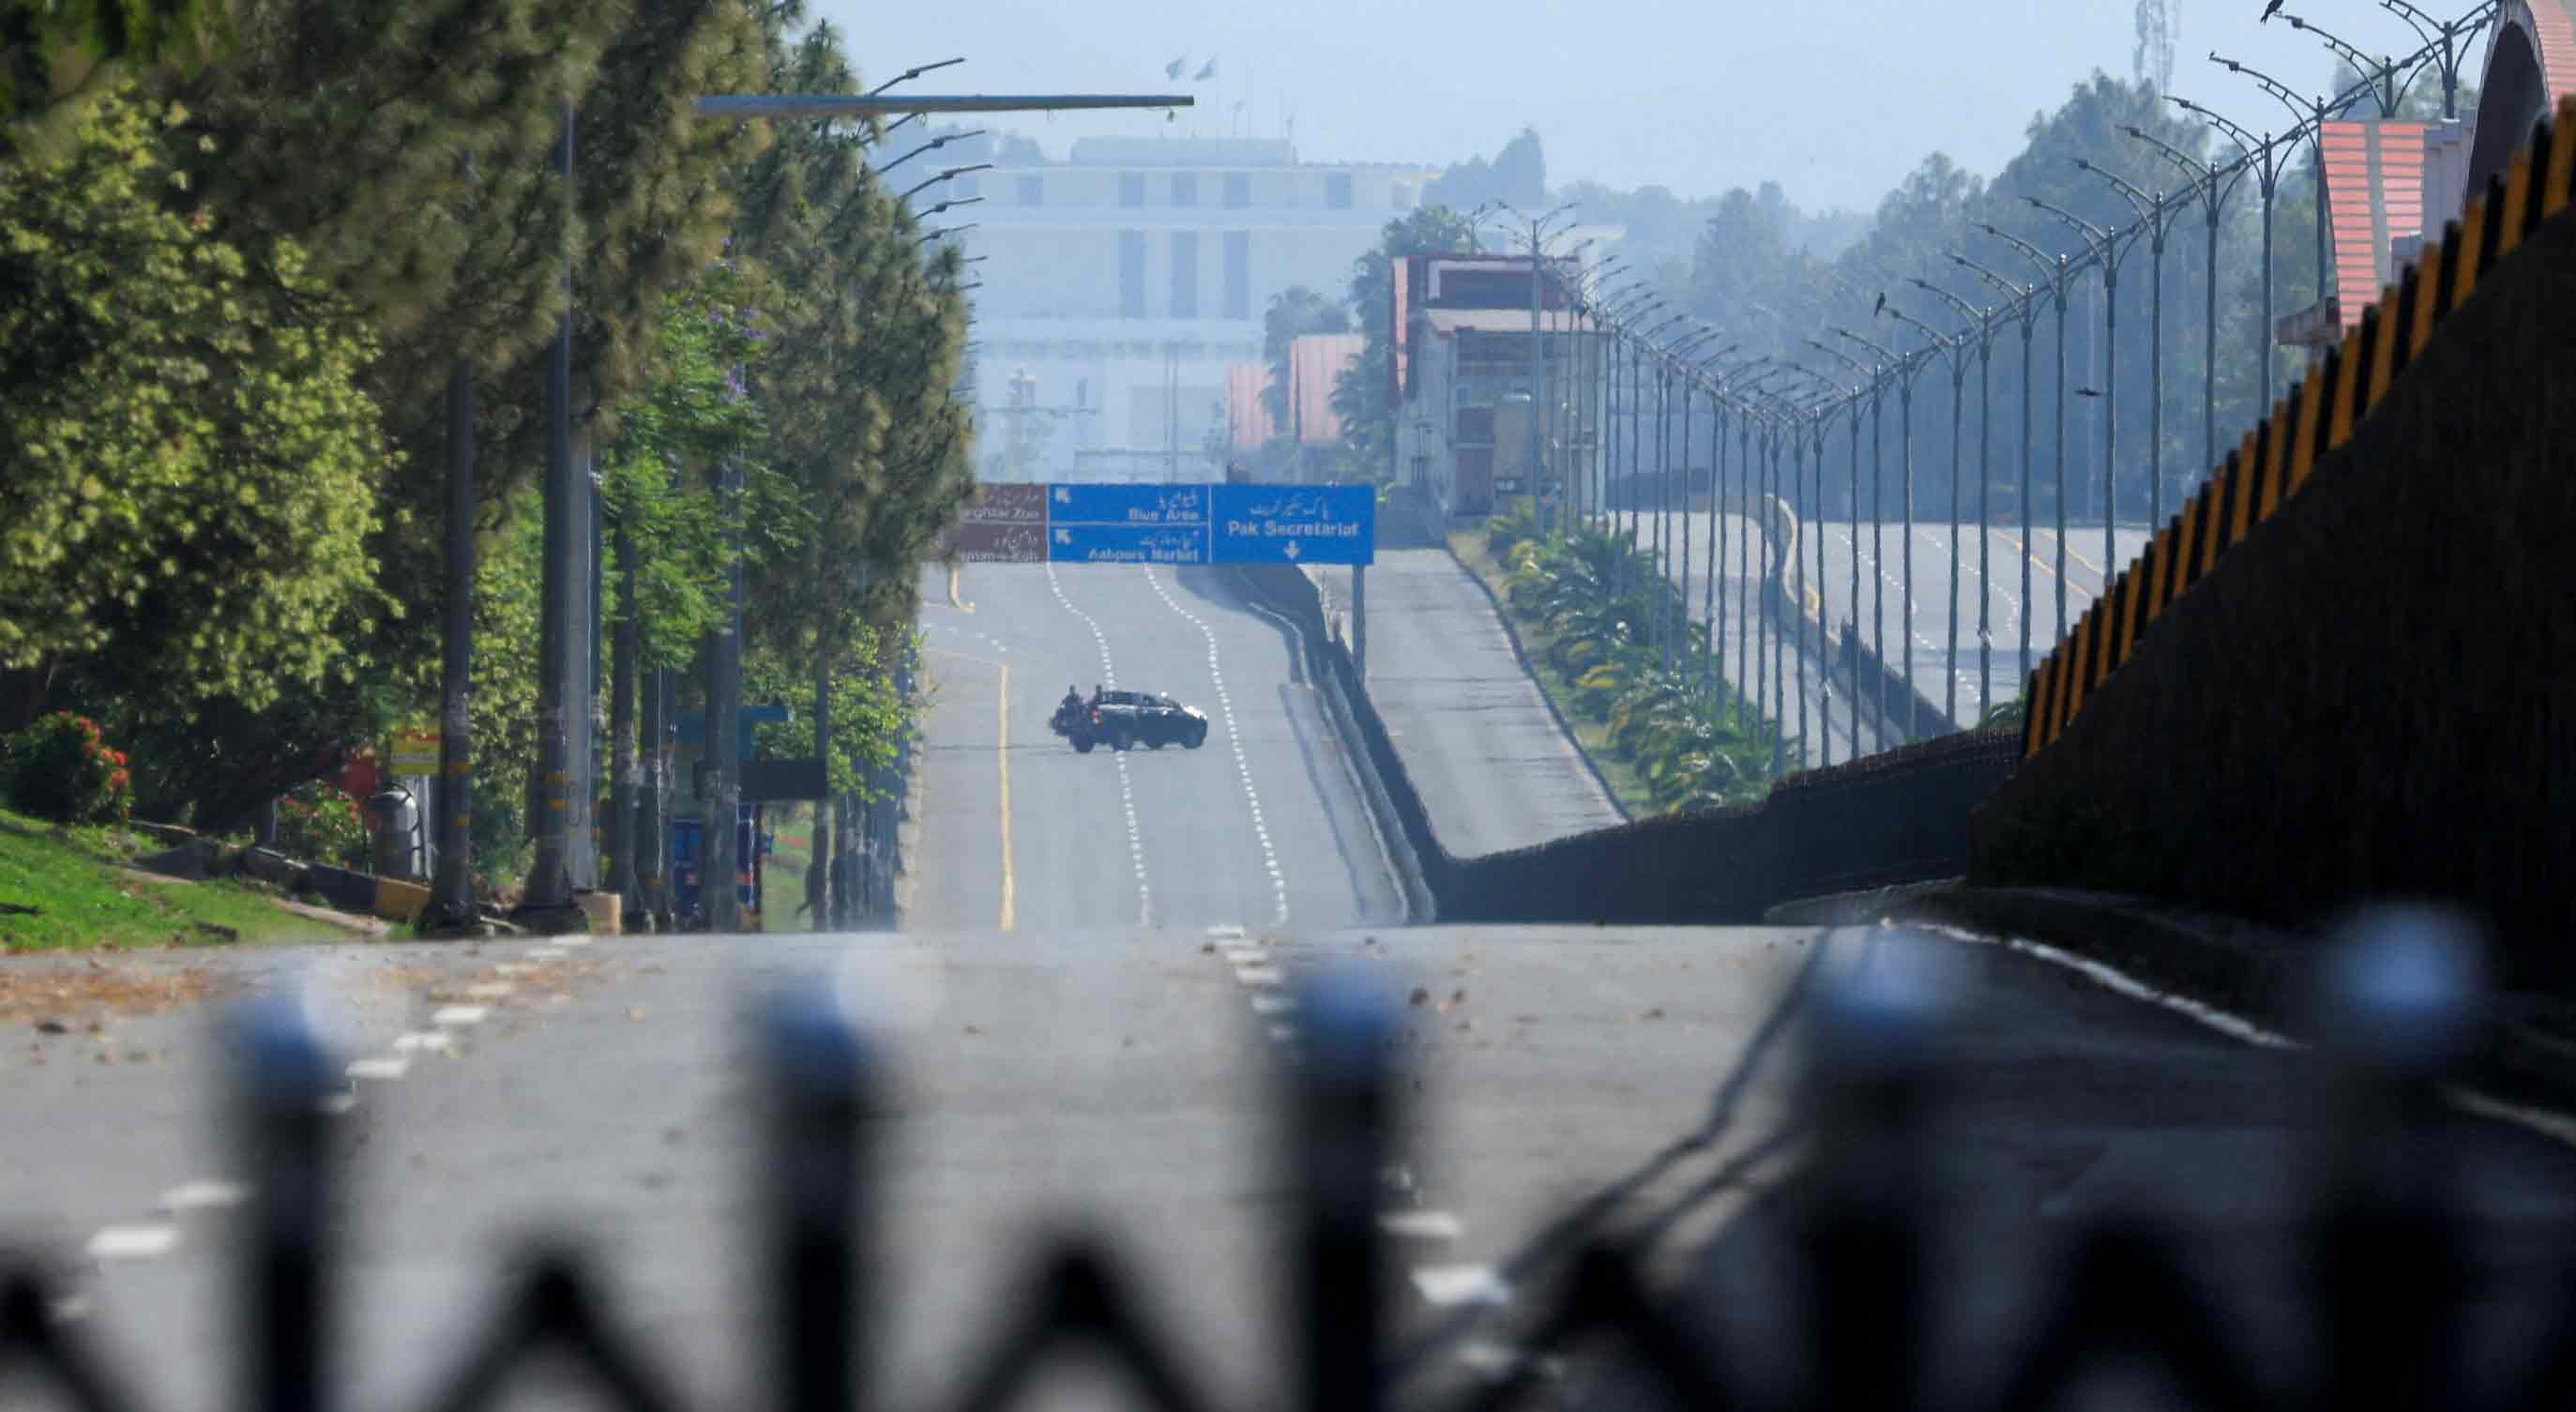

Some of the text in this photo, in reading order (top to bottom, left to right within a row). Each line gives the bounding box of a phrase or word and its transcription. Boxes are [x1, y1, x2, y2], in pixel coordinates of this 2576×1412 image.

[1129, 509, 1199, 521] Blue Area
[1228, 520, 1359, 537] Pak Secretariat
[1151, 548, 1199, 561] Market
